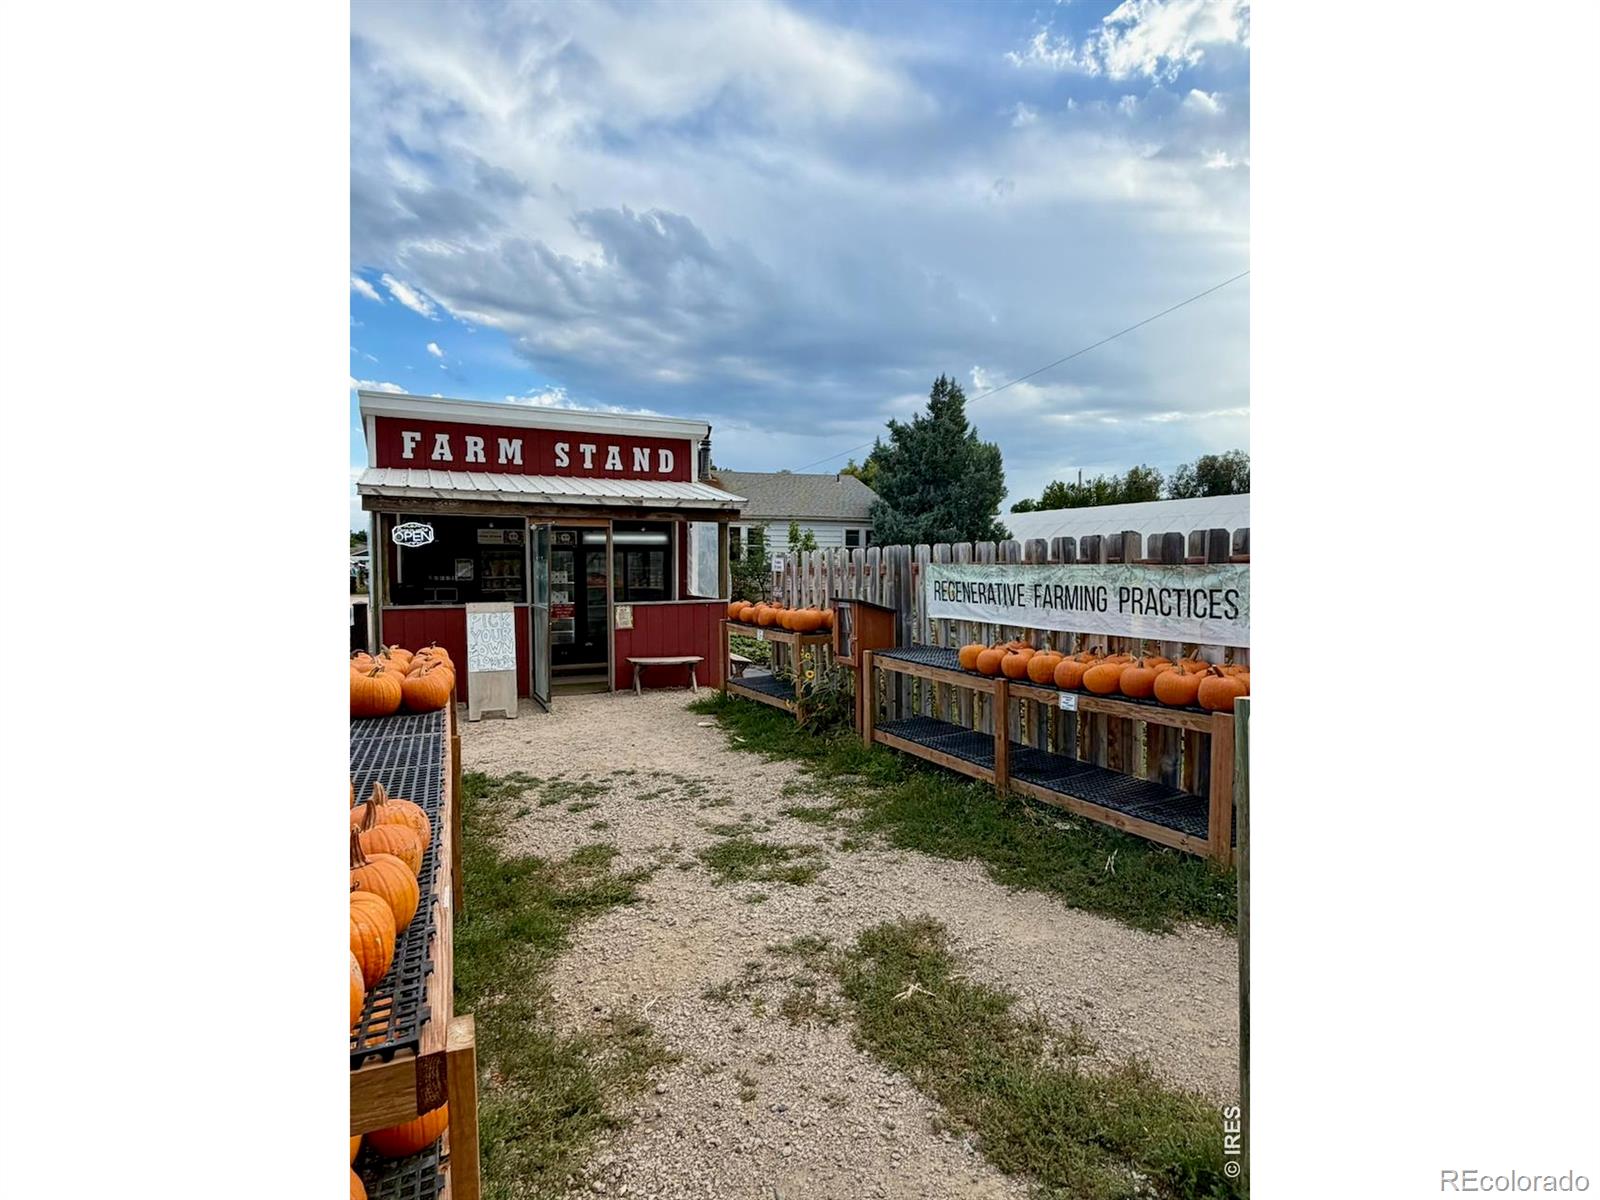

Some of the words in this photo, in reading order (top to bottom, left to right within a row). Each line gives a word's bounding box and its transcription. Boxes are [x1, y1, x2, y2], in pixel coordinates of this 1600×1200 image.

[401, 431, 523, 465] FARM
[555, 442, 675, 473] STAND
[394, 530, 431, 542] OPEN
[934, 580, 1026, 608] REGENERATIVE
[1034, 584, 1108, 613] FARMING
[1119, 586, 1240, 620] PRACTICES
[470, 613, 512, 629] PICK
[471, 628, 514, 643] YOUR
[479, 641, 515, 656] OWN
